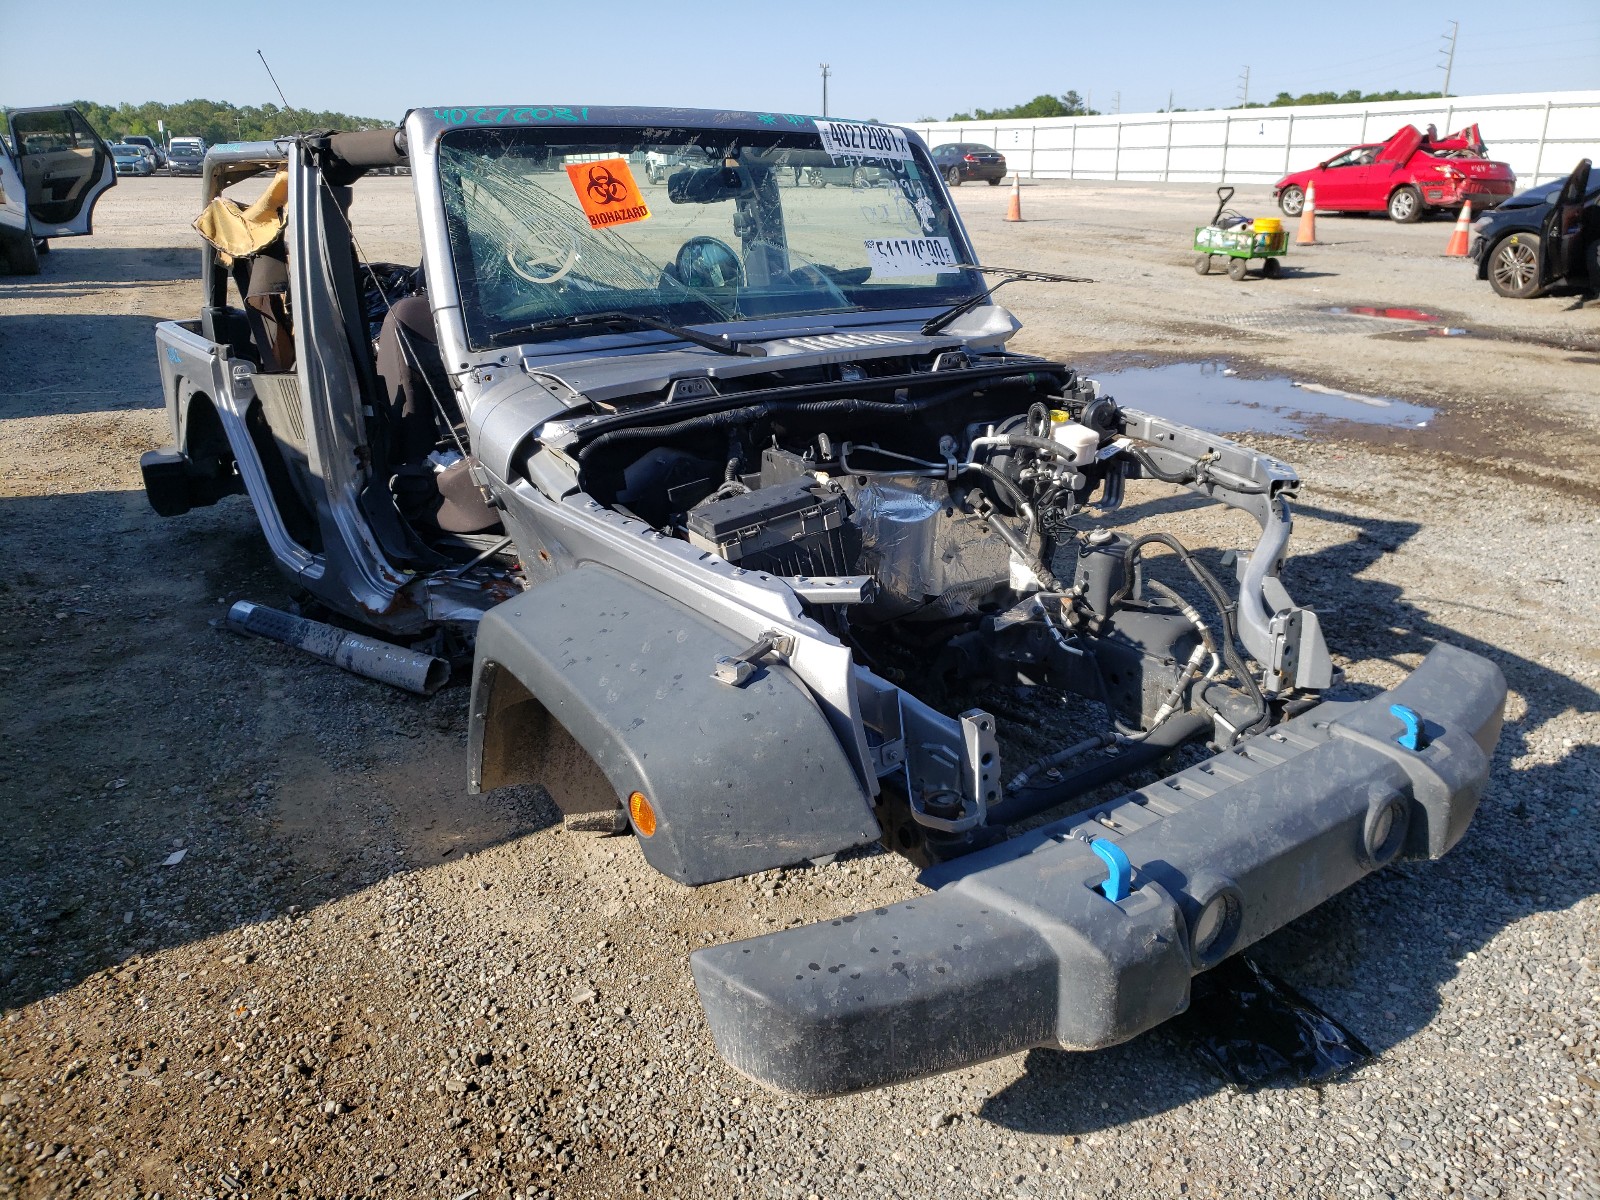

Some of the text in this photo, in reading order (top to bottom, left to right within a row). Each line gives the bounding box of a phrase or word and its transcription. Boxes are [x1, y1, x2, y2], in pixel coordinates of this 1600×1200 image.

[434, 107, 589, 125] 40272081
[829, 123, 899, 152] 40272081
[588, 205, 649, 226] BIOHAZARD
